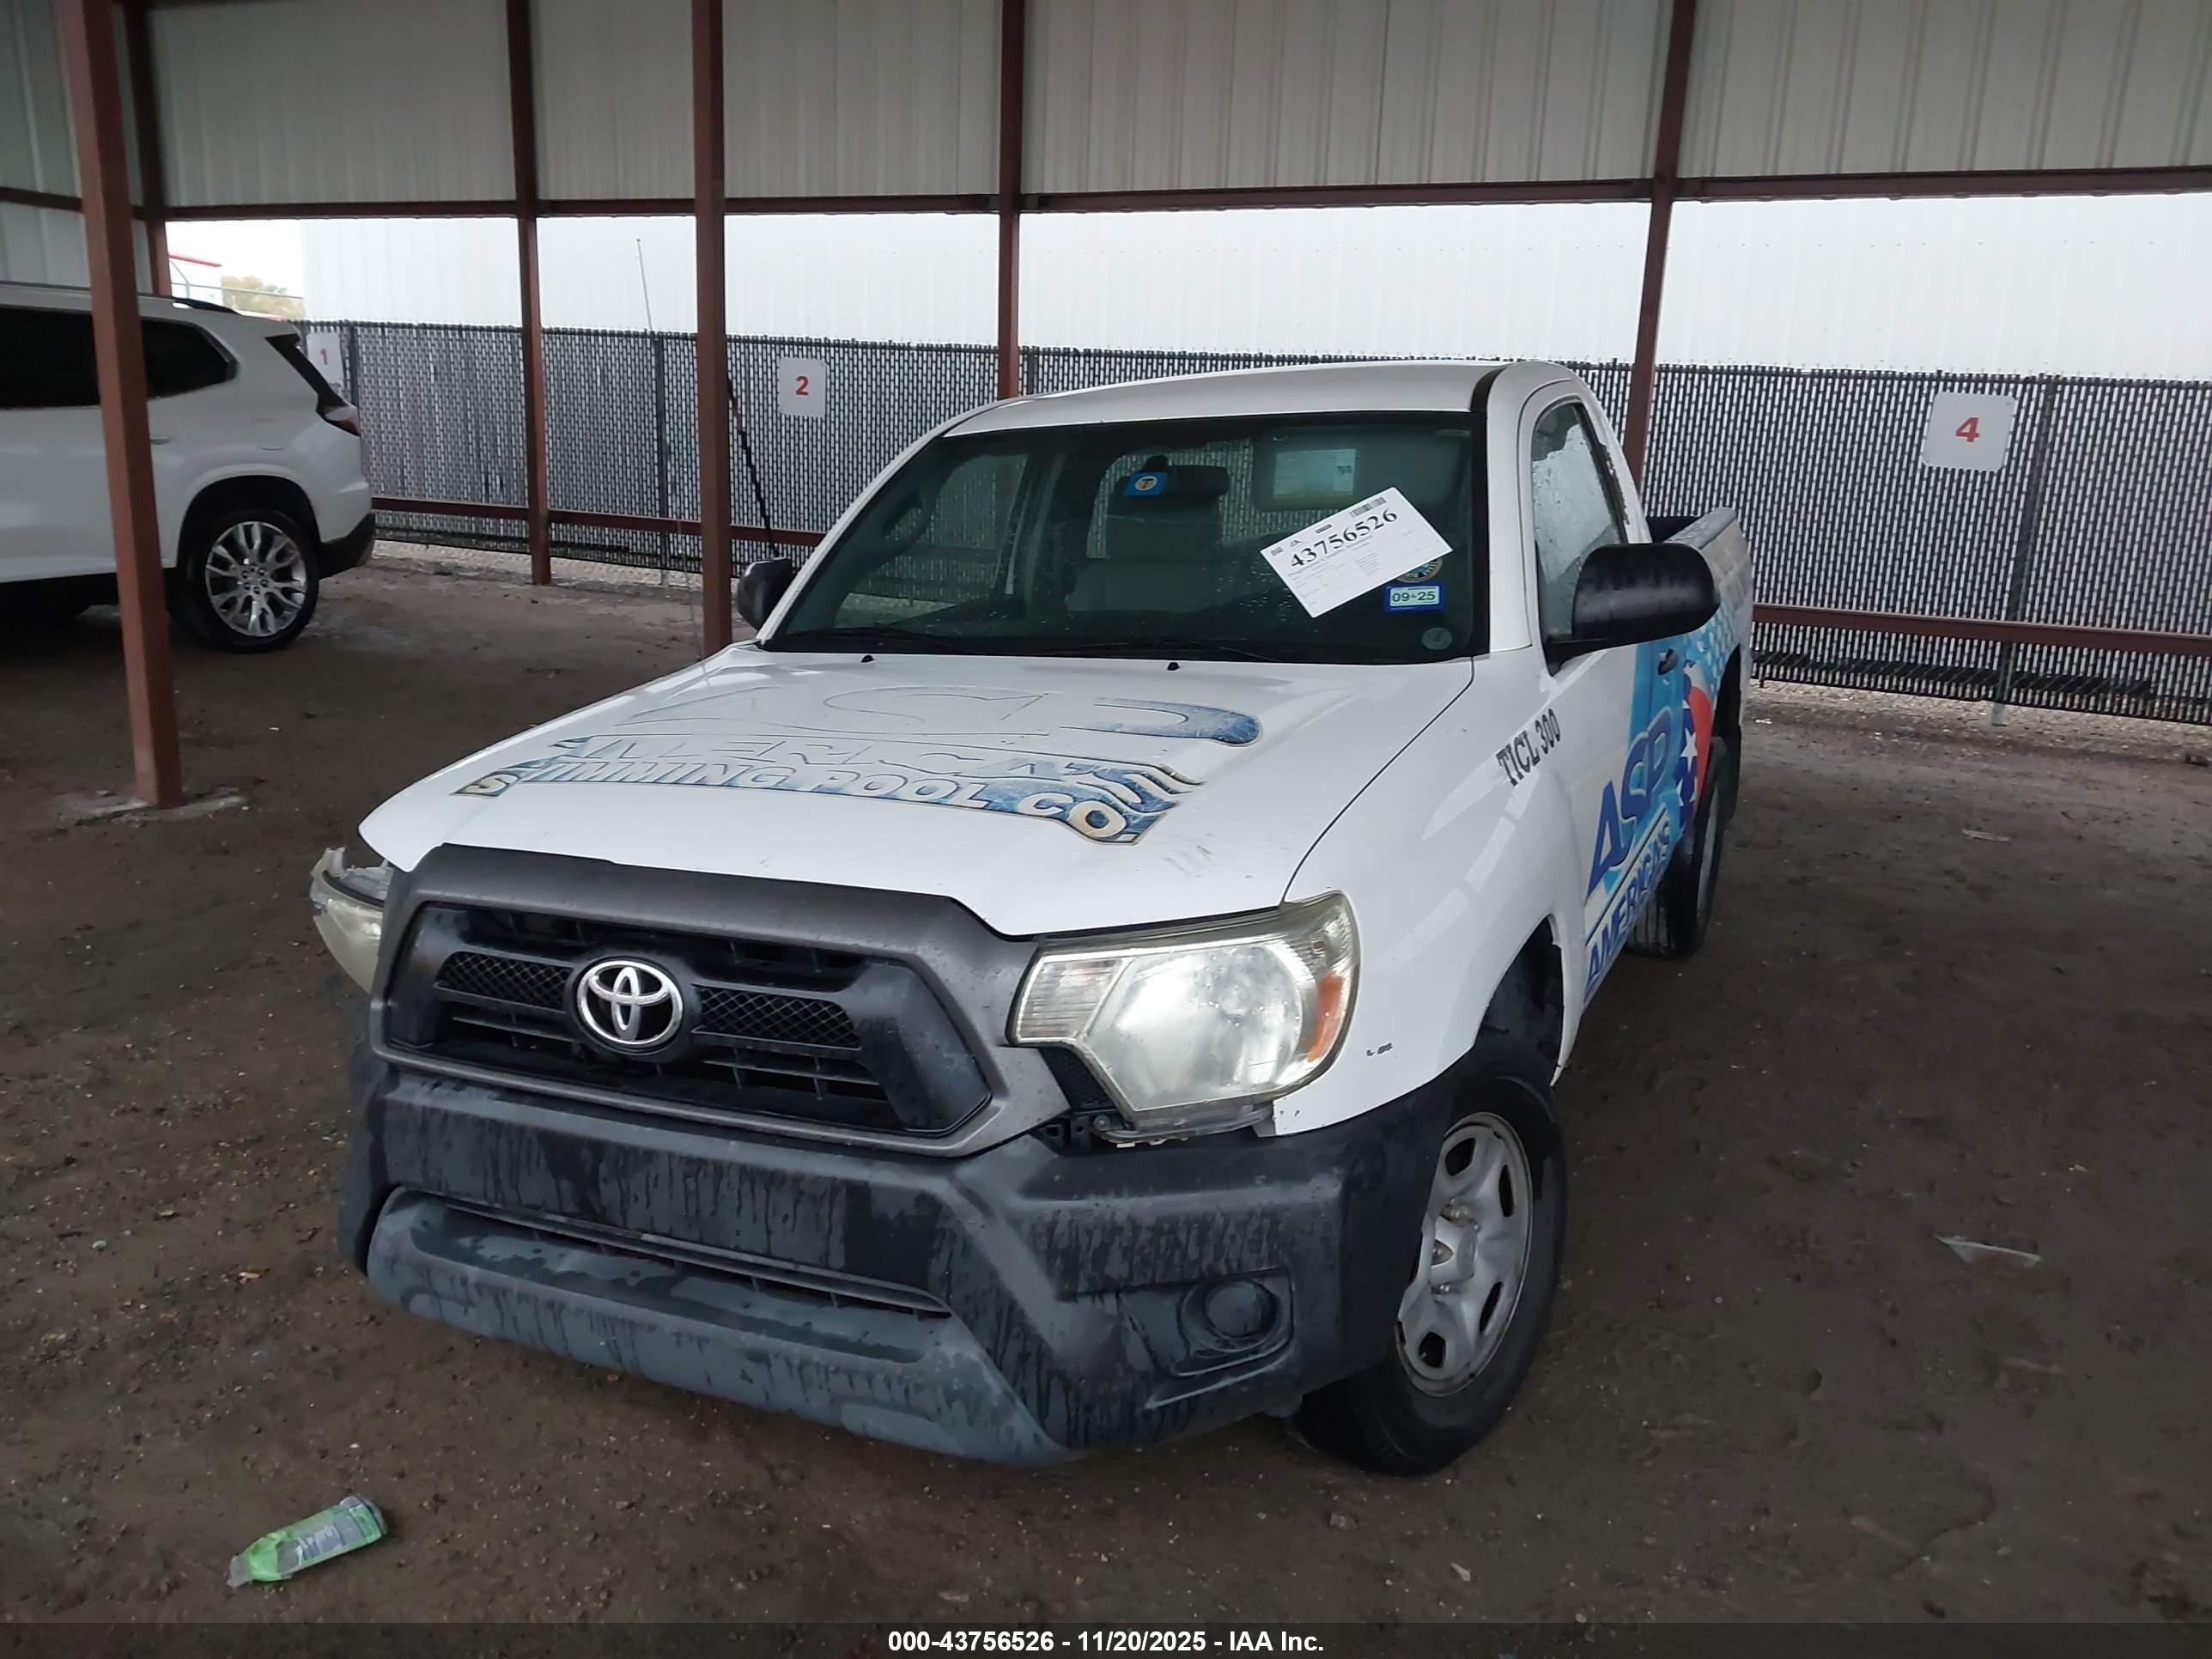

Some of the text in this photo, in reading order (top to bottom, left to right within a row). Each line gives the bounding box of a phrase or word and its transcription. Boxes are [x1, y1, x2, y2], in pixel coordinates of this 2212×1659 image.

[319, 348, 329, 366] 1
[795, 374, 810, 397] 2
[1954, 416, 1980, 443] 4
[1290, 507, 1398, 568] 43756526
[1496, 708, 1562, 787] TICL 300
[800, 769, 991, 810] POOL
[1017, 791, 1140, 842] CO.
